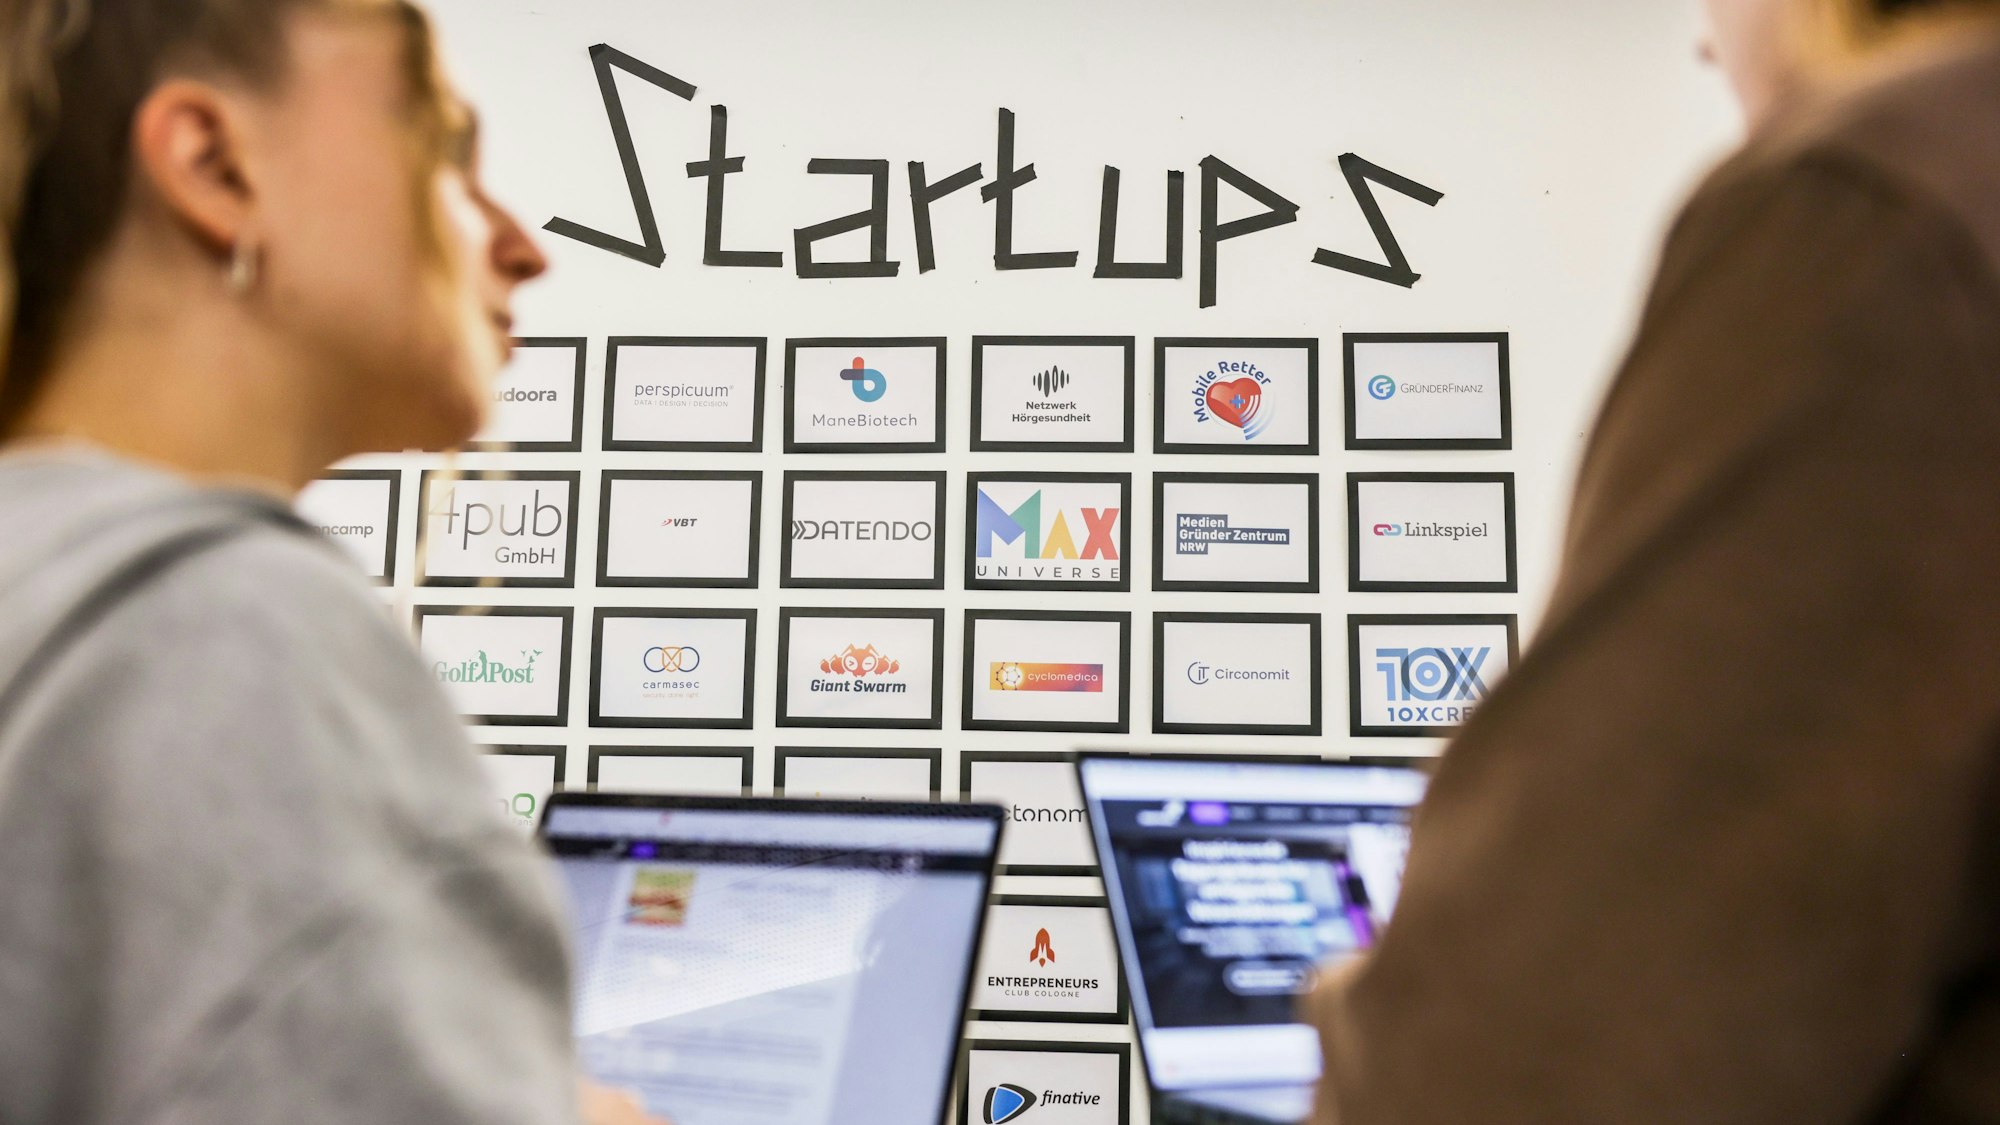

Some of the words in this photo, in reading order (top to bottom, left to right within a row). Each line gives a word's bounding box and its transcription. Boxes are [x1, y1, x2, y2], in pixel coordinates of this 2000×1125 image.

[542, 43, 1444, 307] Startups
[491, 387, 557, 401] udoora
[1191, 370, 1217, 423] Mobile
[1218, 361, 1271, 385] Retter
[693, 400, 728, 408] DECISION
[1025, 401, 1077, 410] Netzwerk
[812, 413, 917, 427] ManeBiotech
[1012, 412, 1091, 423] Hörgesundheit
[673, 518, 698, 527] VBT
[976, 488, 1120, 561] MAX
[1179, 516, 1226, 529] Medien
[803, 520, 932, 541] DATENDO
[1179, 527, 1232, 541] Gründer
[1233, 529, 1287, 542] Zentrum
[1404, 521, 1488, 541] Linkspiel
[1179, 541, 1207, 552] NRW
[494, 546, 556, 565] GmbH
[976, 565, 1120, 579] UNIVERSE
[433, 660, 479, 683] Golf
[487, 661, 534, 684] Post
[1028, 671, 1099, 683] cyclomedica
[1214, 668, 1290, 680] Circonomit
[642, 681, 700, 689] carmasec
[810, 679, 851, 693] Giant
[853, 680, 907, 694] Swarm
[1387, 706, 1474, 722] 10XCRE
[988, 976, 1099, 989] ENTREPRENEURS
[1004, 989, 1029, 997] CLUB
[1034, 990, 1080, 998] COLOGNE
[1040, 1089, 1101, 1106] finative
